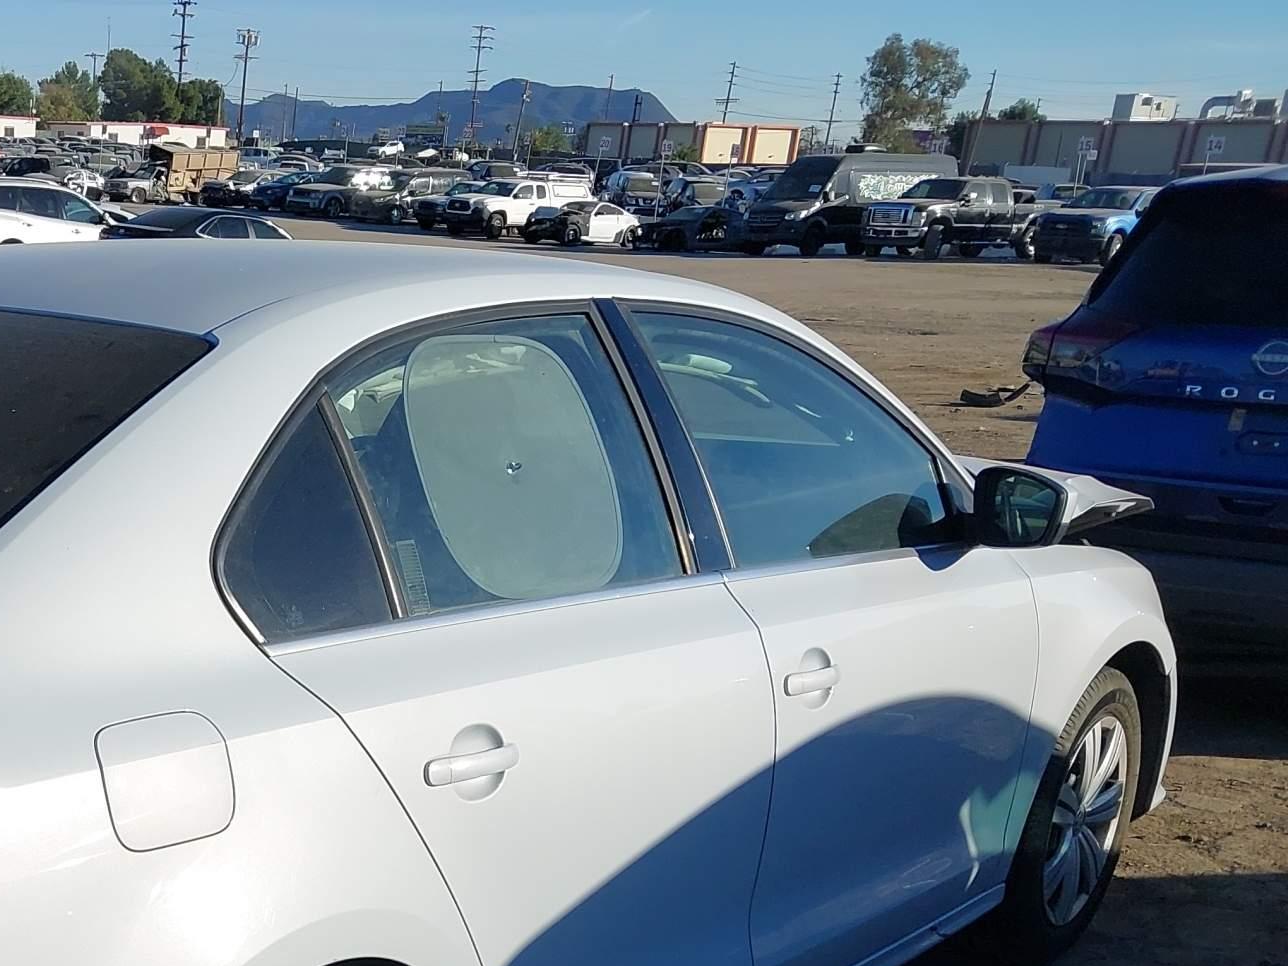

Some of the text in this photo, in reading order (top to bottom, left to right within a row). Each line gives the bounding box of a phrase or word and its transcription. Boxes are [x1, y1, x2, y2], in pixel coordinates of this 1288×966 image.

[600, 139, 610, 149] 20
[663, 143, 672, 151] 19
[1079, 140, 1092, 151] 15
[1208, 139, 1222, 151] 14
